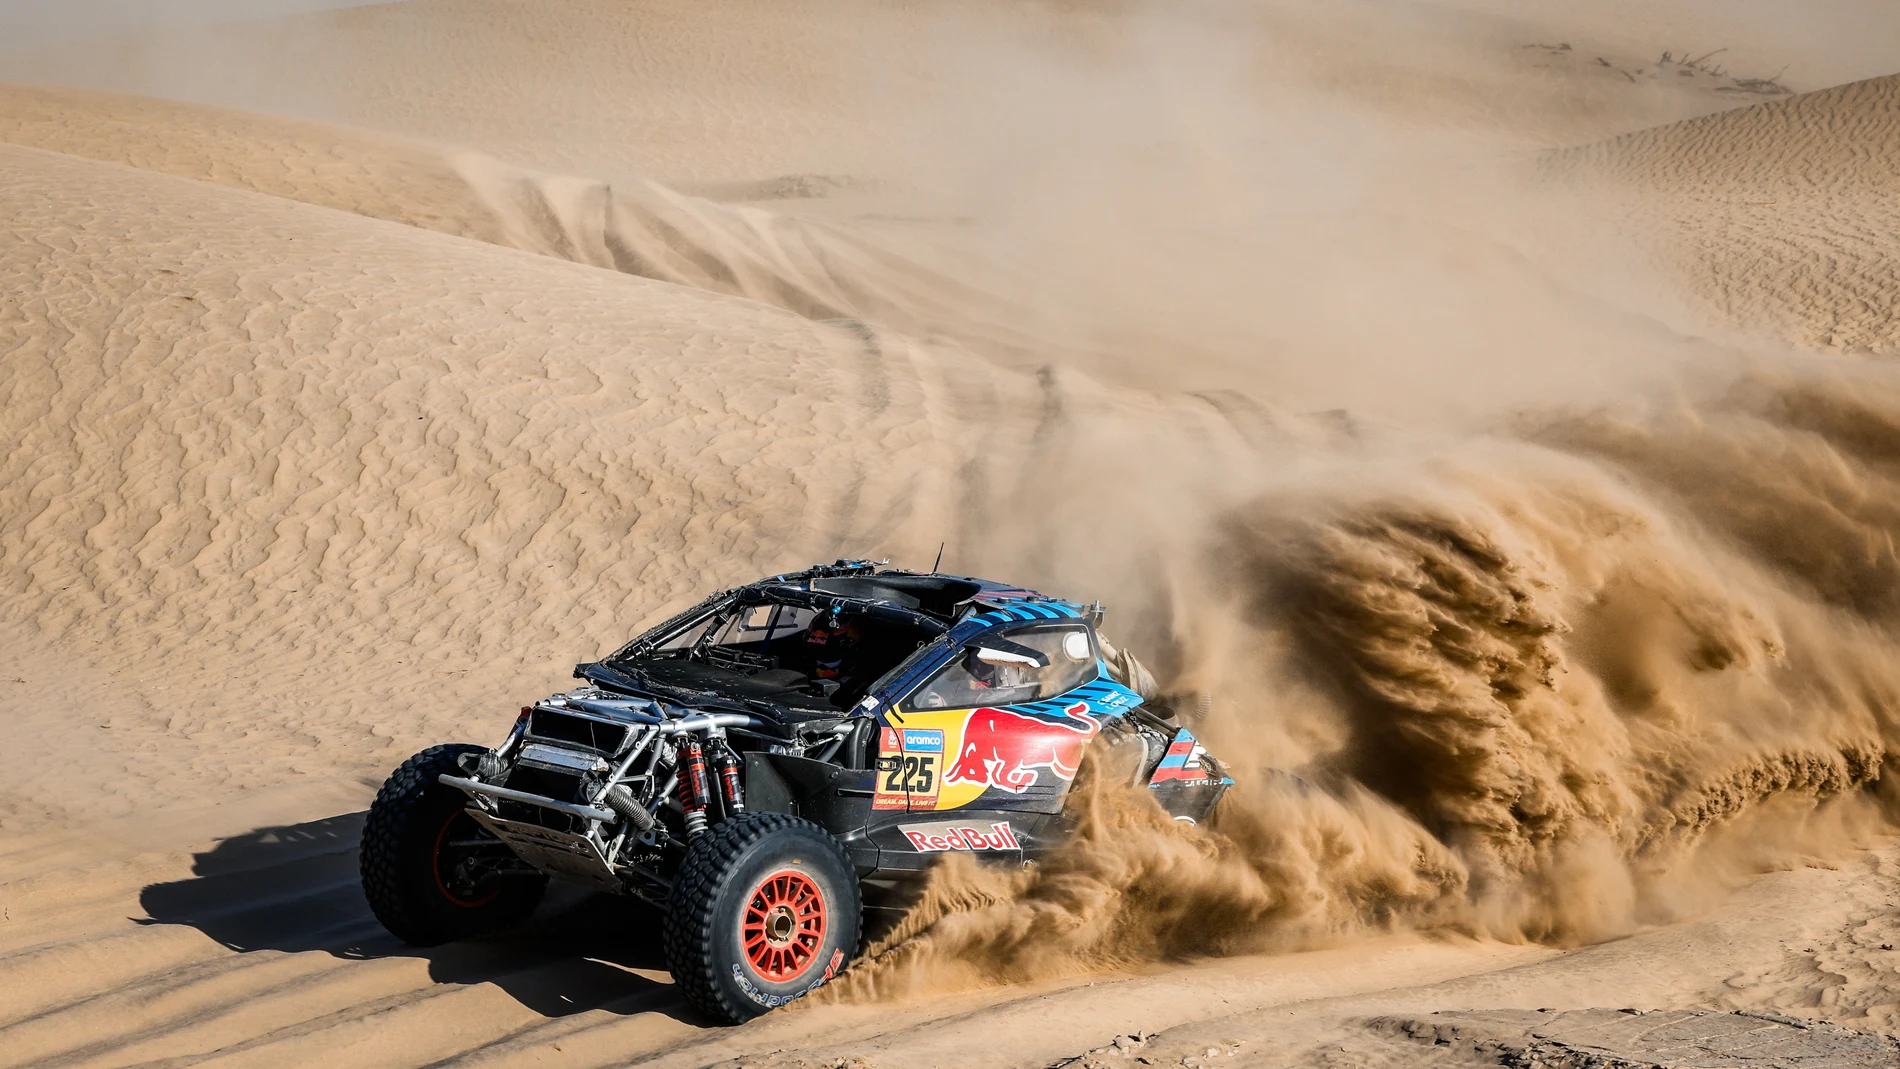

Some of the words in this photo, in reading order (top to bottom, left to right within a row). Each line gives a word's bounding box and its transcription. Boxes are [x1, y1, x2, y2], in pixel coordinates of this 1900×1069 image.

[907, 735, 940, 745] aramco
[885, 755, 934, 793] 225
[905, 828, 968, 851] Red
[959, 823, 1019, 850] Bull
